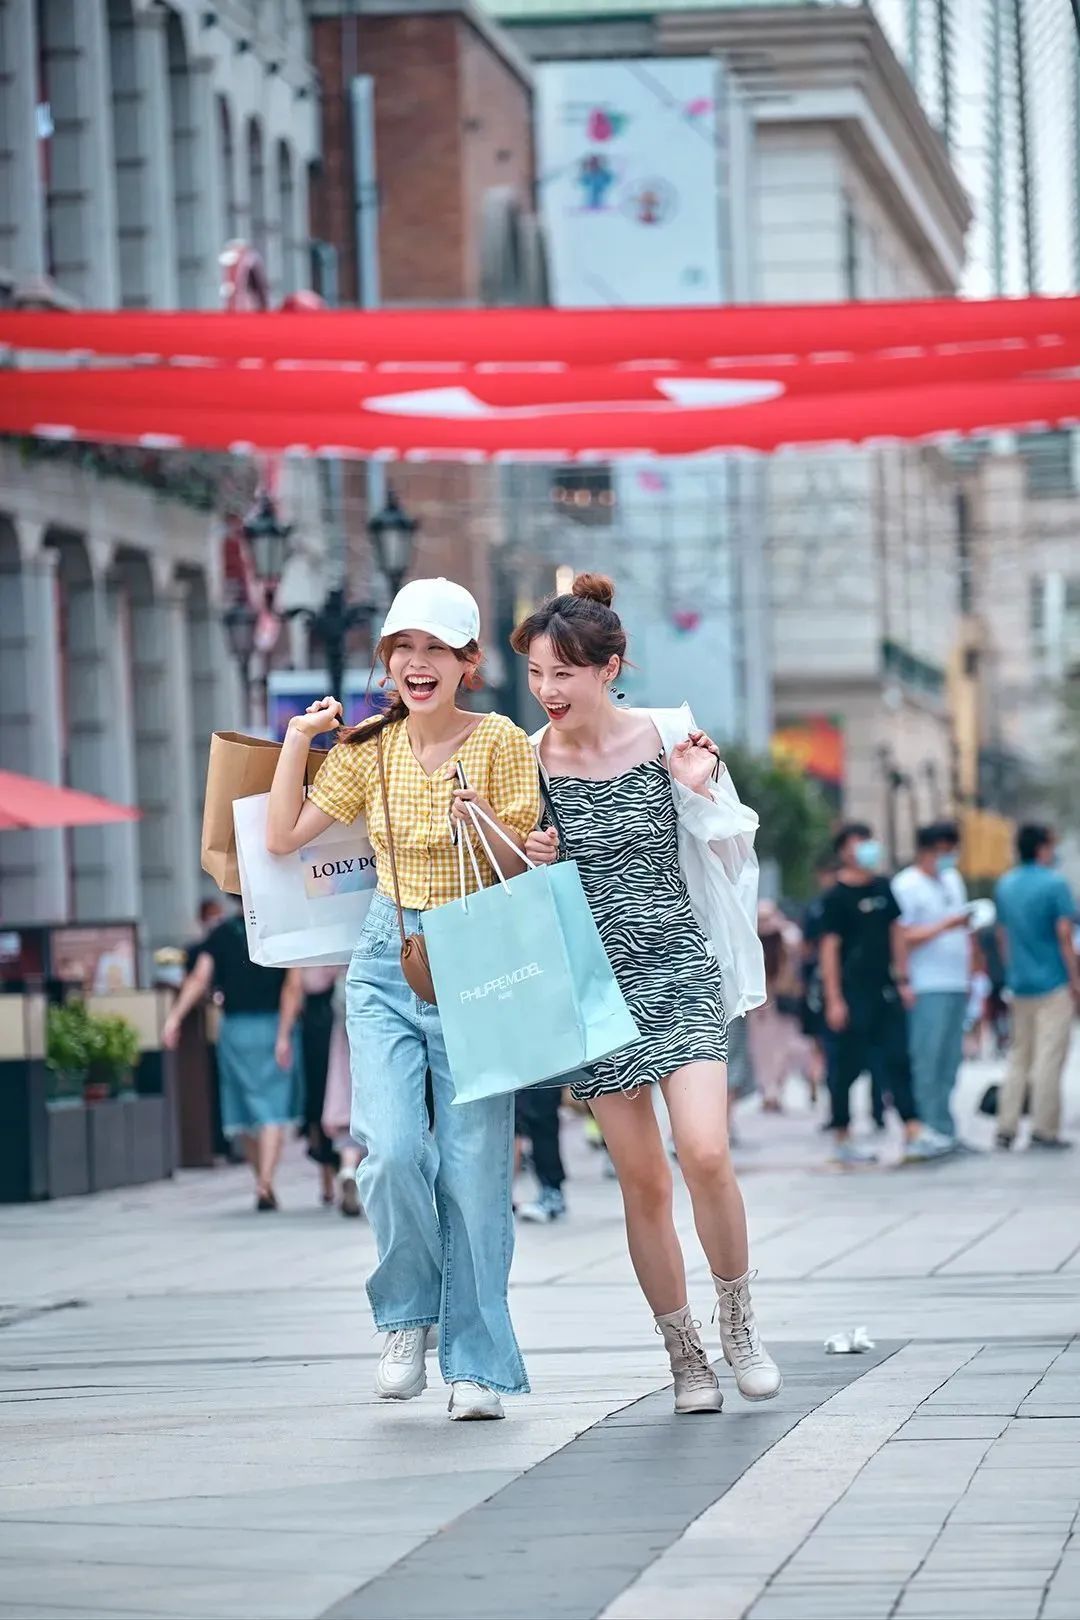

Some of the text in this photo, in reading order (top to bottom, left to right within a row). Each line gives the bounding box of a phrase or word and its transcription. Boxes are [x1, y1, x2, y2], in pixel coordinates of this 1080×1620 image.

[312, 859, 354, 878] LOLY
[459, 976, 507, 1004] PHILIPPE
[505, 962, 545, 986] MODEL
